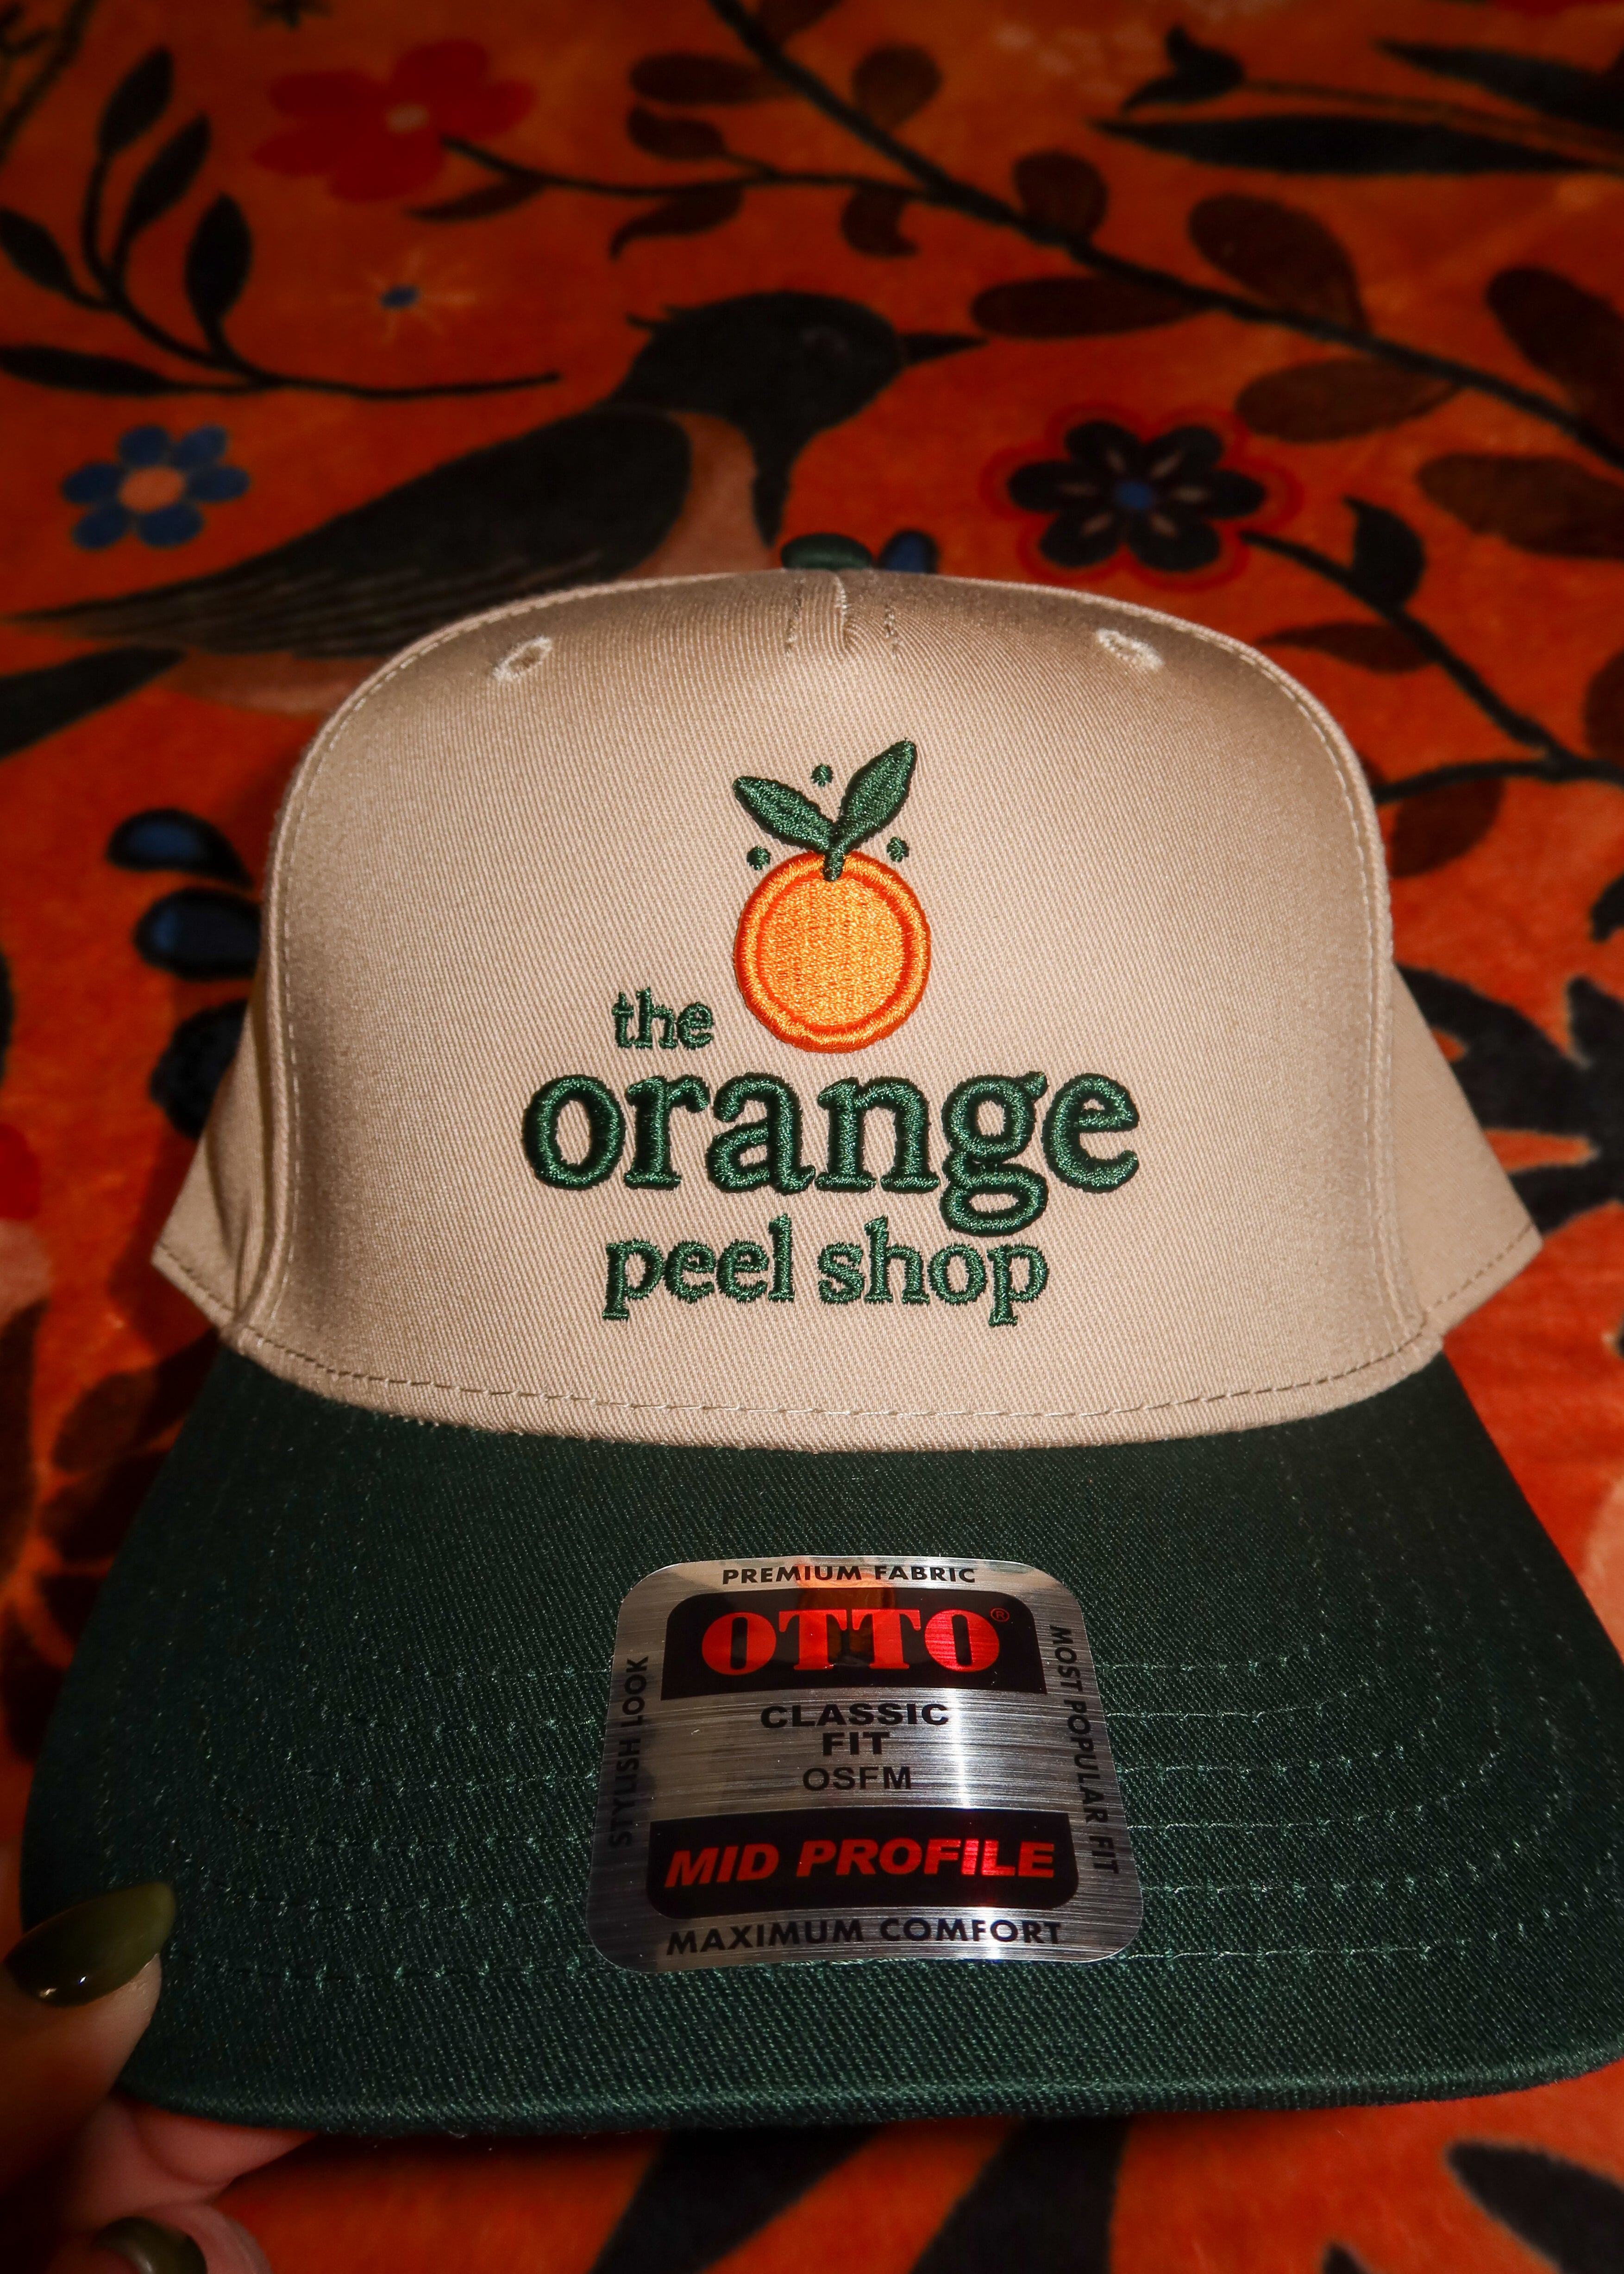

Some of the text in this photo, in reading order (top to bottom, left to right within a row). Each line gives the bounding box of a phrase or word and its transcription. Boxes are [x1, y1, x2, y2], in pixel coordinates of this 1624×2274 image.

[612, 987, 713, 1049] the
[522, 1071, 1139, 1236] orange
[602, 1214, 1048, 1326] peel shop
[722, 1565, 975, 1584] PREMIUM FABRIC
[761, 1703, 948, 1728] CLASSIC
[608, 1656, 648, 1848] STYLISH LOOK
[823, 1732, 890, 1756] FIT
[1049, 1625, 1119, 1874] MOST POPULAR FIT
[803, 1766, 911, 1790] OSFM
[665, 1838, 1054, 1888] MID PROFILE
[666, 1917, 1061, 1955] MAXIMUM COMFORT
